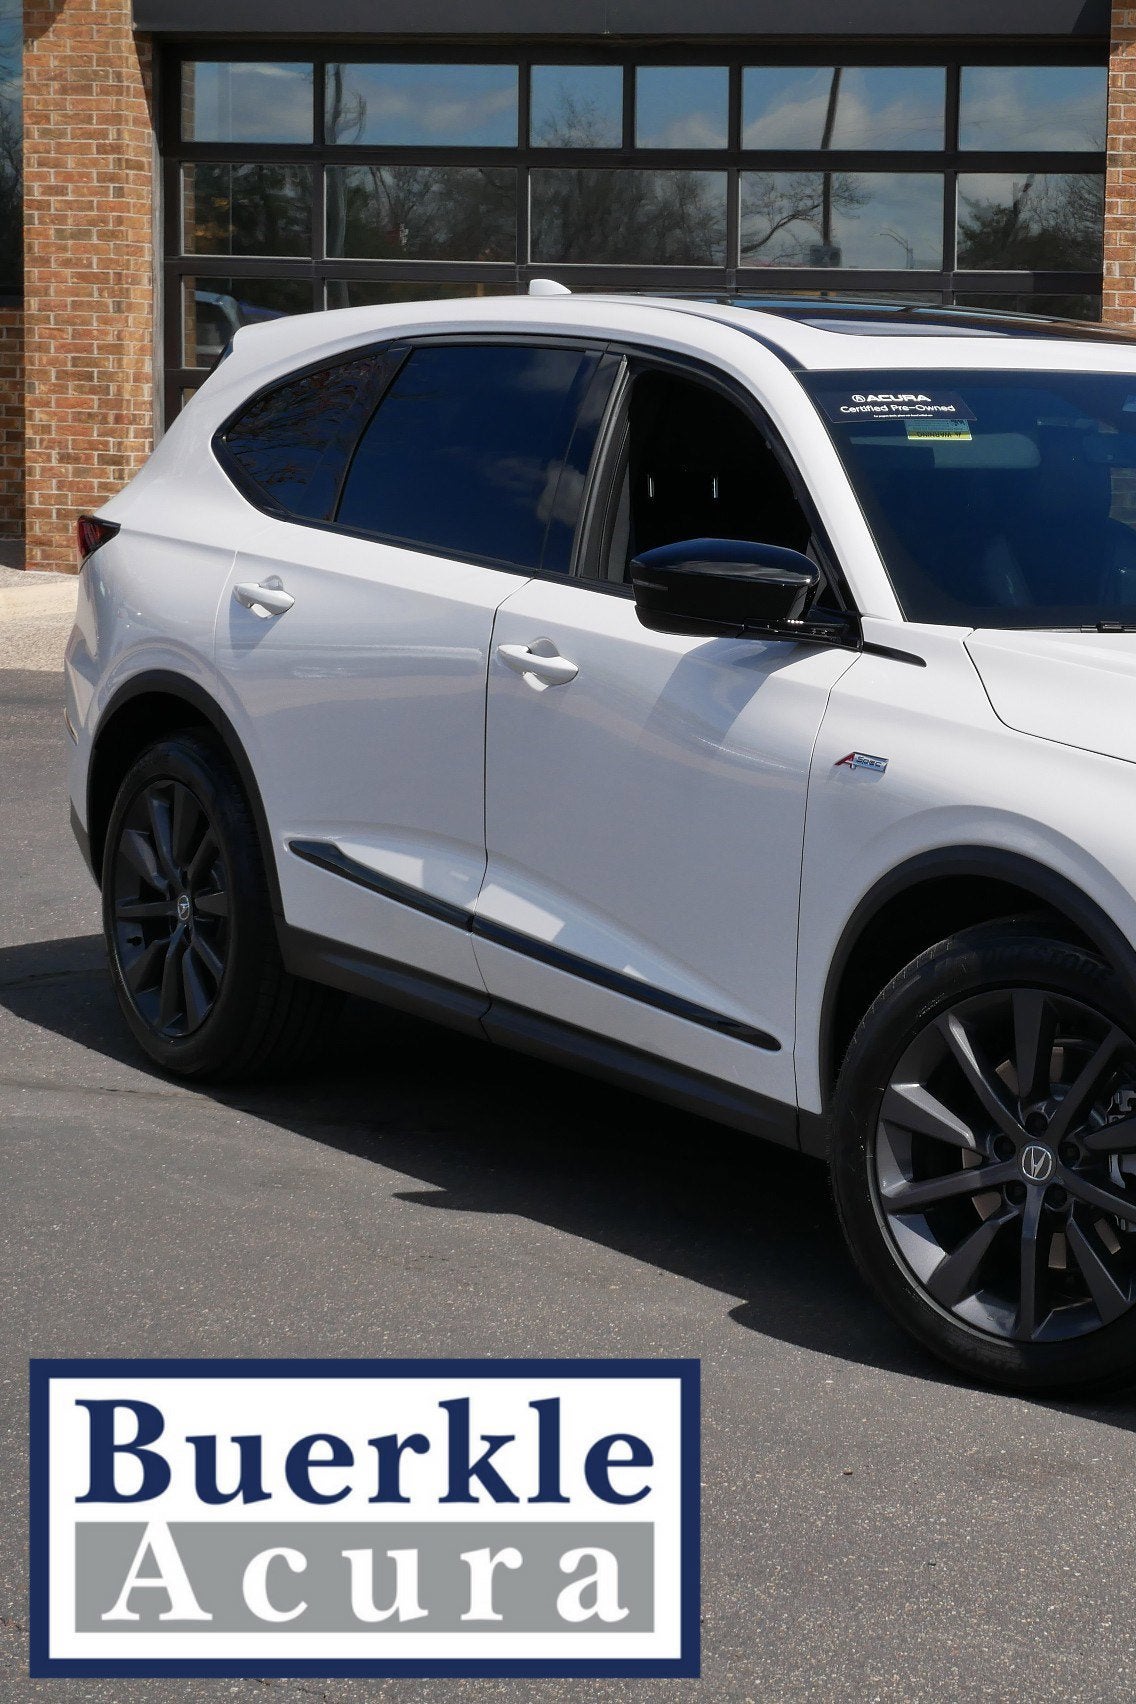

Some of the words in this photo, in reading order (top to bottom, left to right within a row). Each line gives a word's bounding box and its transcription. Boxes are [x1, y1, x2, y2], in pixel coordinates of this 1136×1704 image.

[866, 394, 932, 402] ACURA
[840, 404, 889, 413] Certified
[890, 404, 956, 412] Pre-Owned
